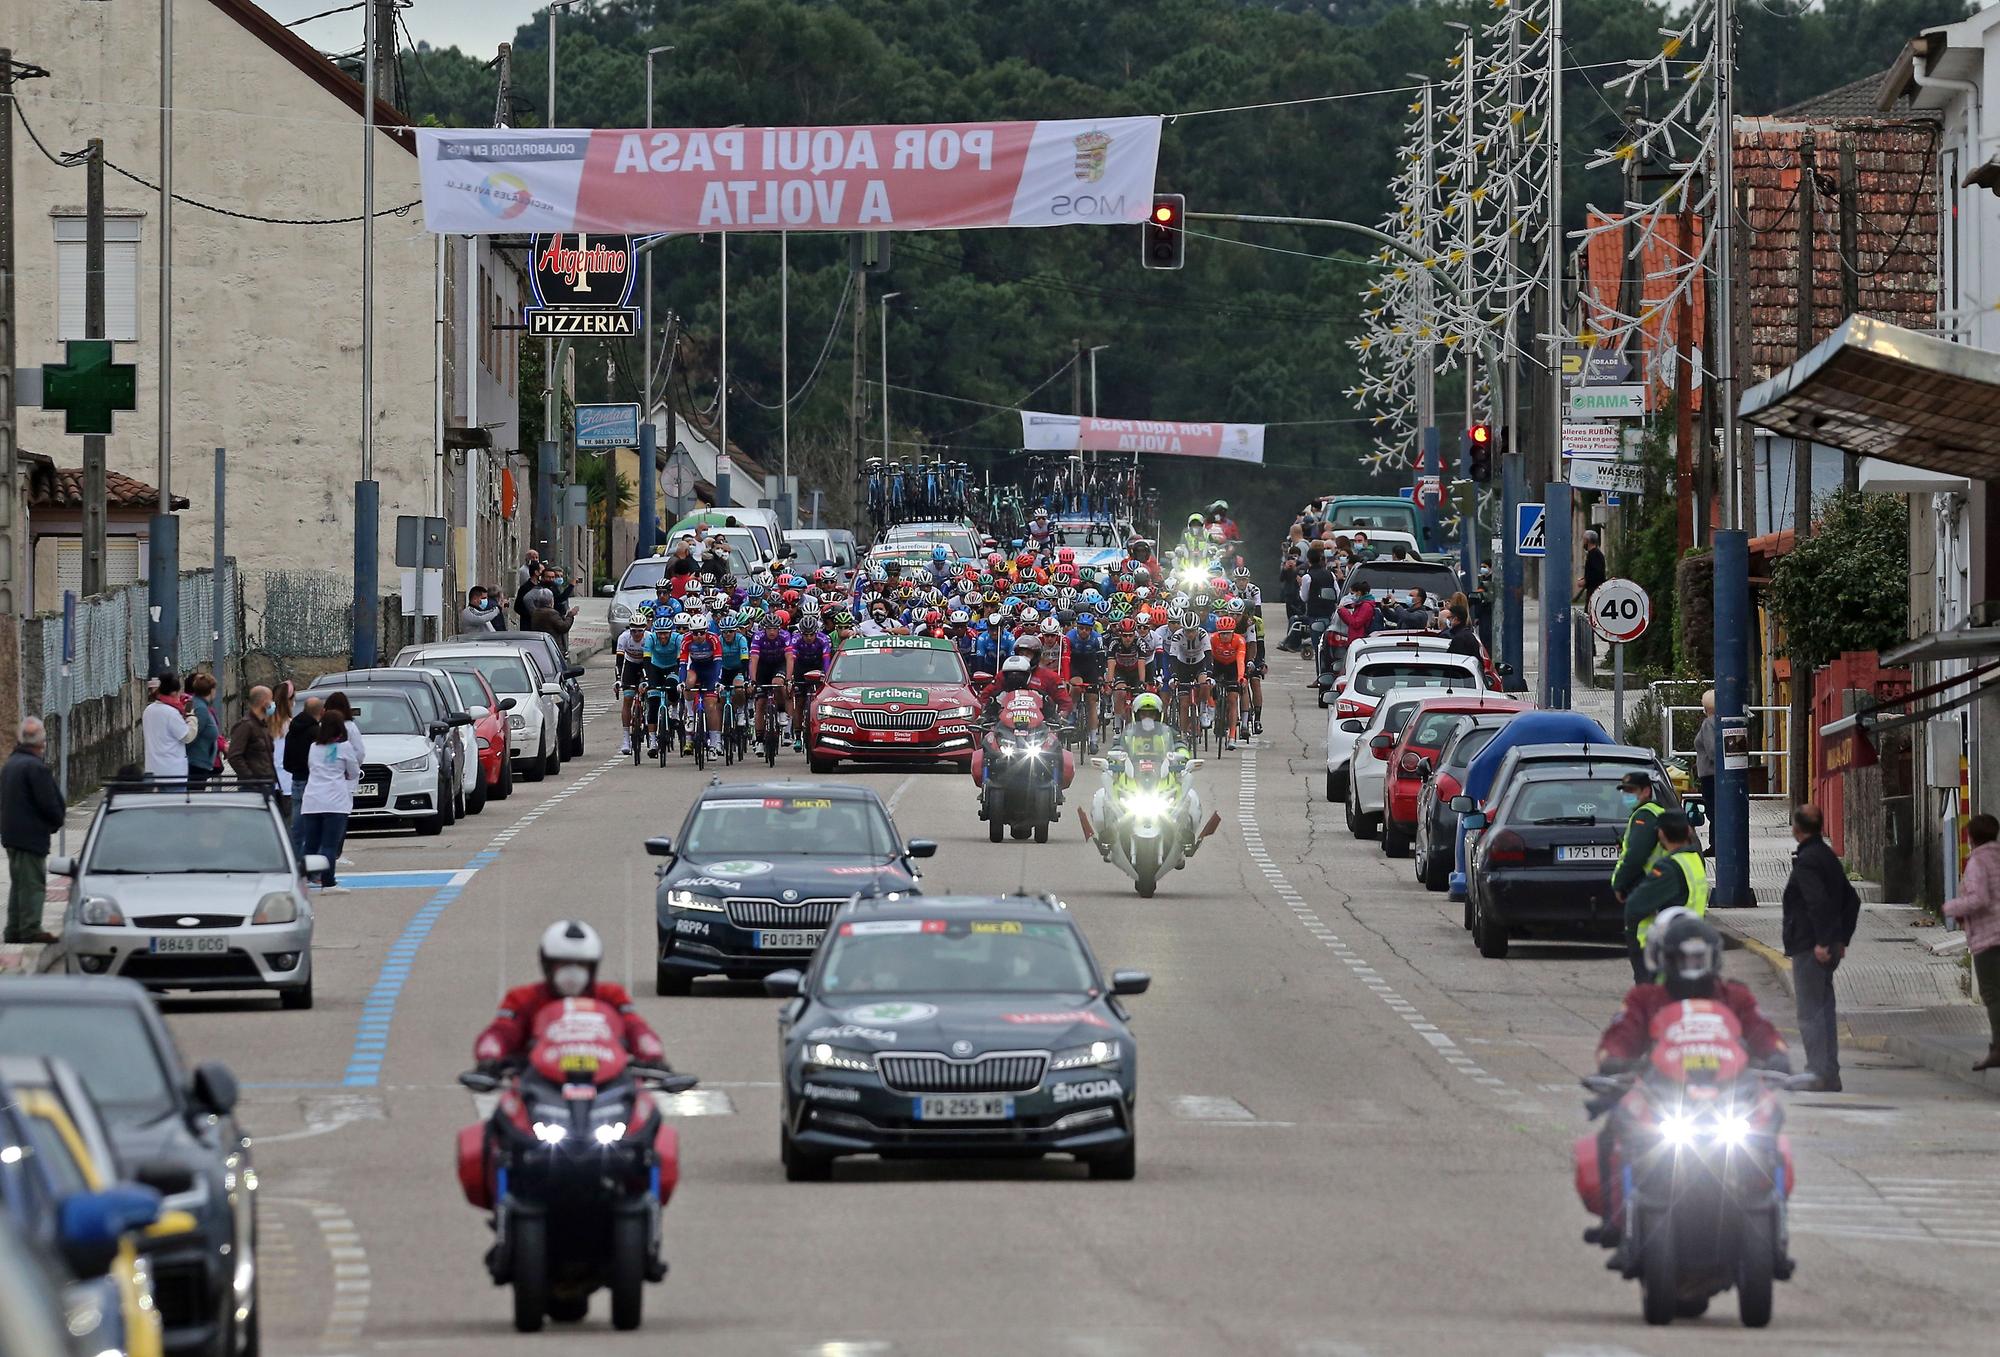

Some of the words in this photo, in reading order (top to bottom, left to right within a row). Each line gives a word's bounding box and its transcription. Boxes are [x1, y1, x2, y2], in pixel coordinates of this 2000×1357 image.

[539, 233, 626, 285] Argentino
[535, 315, 630, 332] PIZZERIA
[1586, 395, 1629, 408] RAMA
[1600, 598, 1638, 620] 40
[864, 638, 931, 649] Fertiberia
[868, 689, 923, 699] Fertiberia
[820, 723, 854, 735] ŠKODA
[938, 724, 968, 735] ŠKOD
[1568, 847, 1596, 858] 1751
[675, 920, 710, 935] RRPP4
[159, 938, 193, 951] 8849
[1053, 1080, 1122, 1103] ŠKODA
